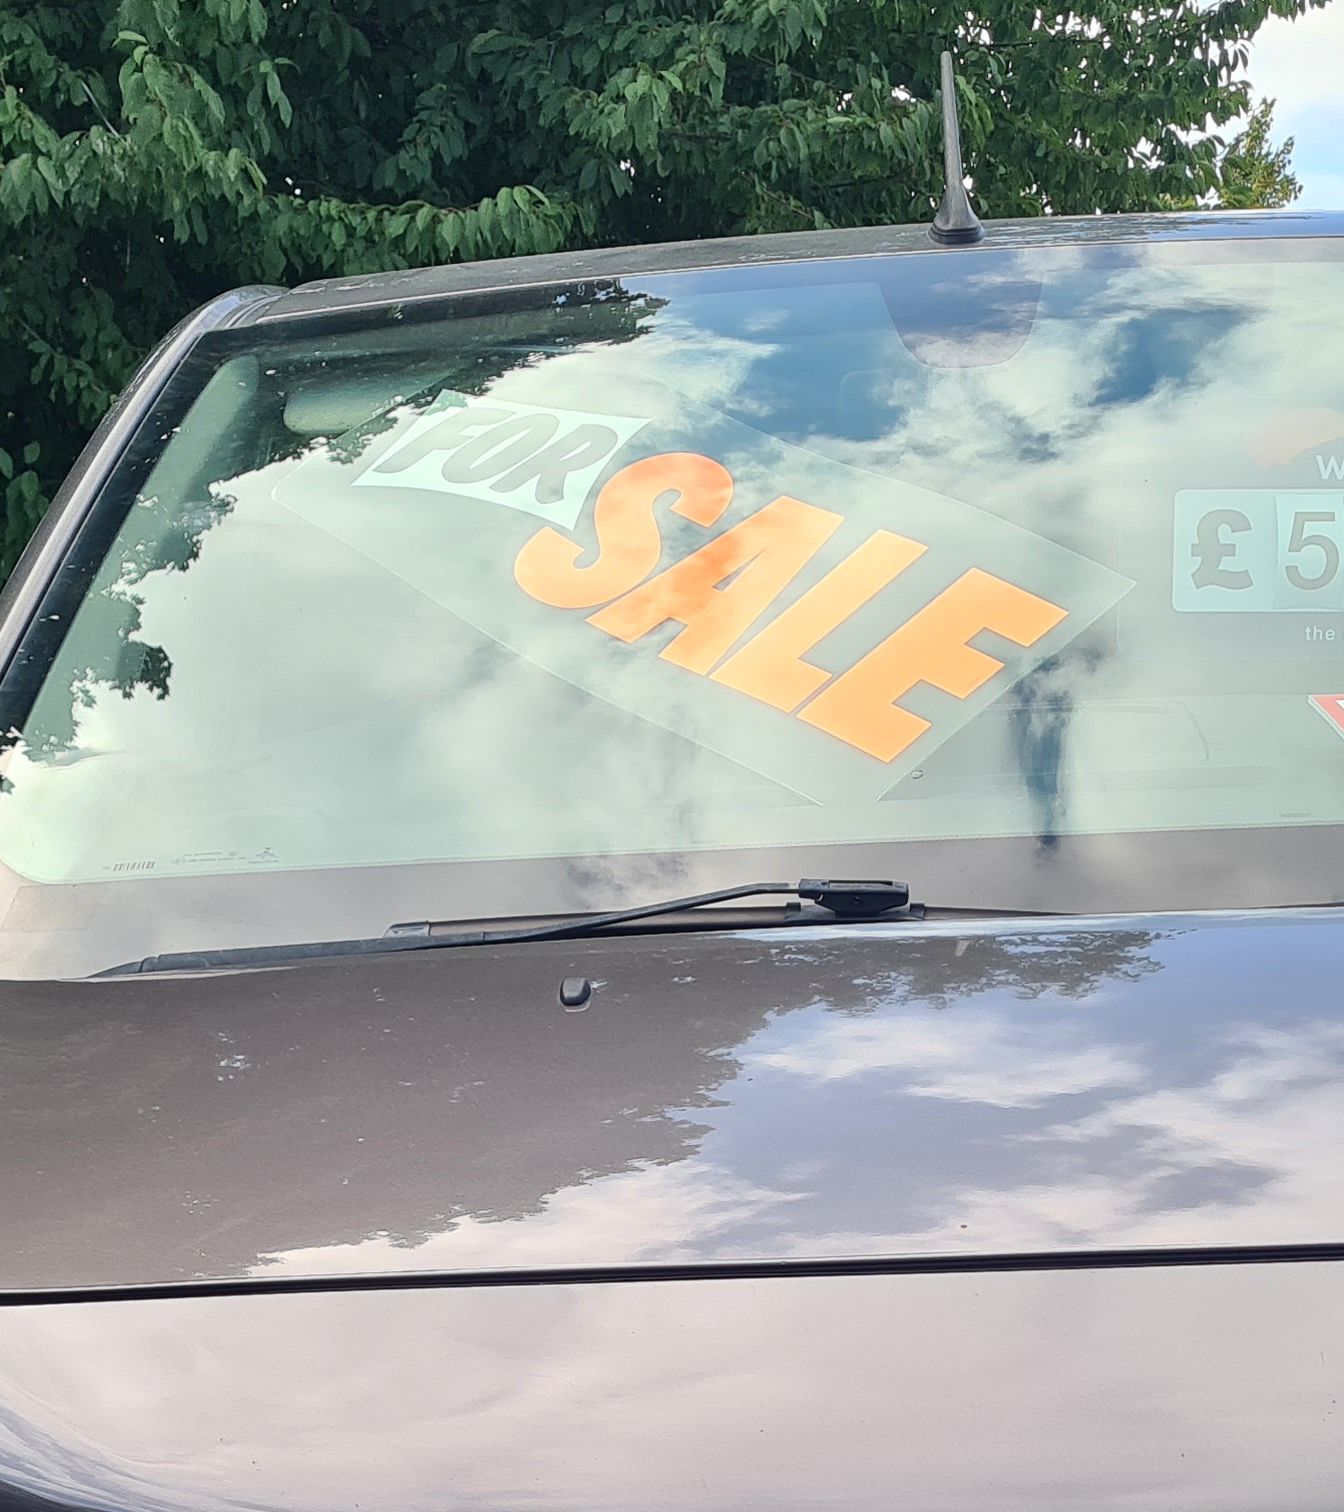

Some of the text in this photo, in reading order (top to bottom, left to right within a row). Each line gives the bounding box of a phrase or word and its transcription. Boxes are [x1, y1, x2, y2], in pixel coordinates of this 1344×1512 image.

[372, 405, 618, 503] FOR
[514, 451, 1070, 763] SALE
[1305, 626, 1335, 640] the
